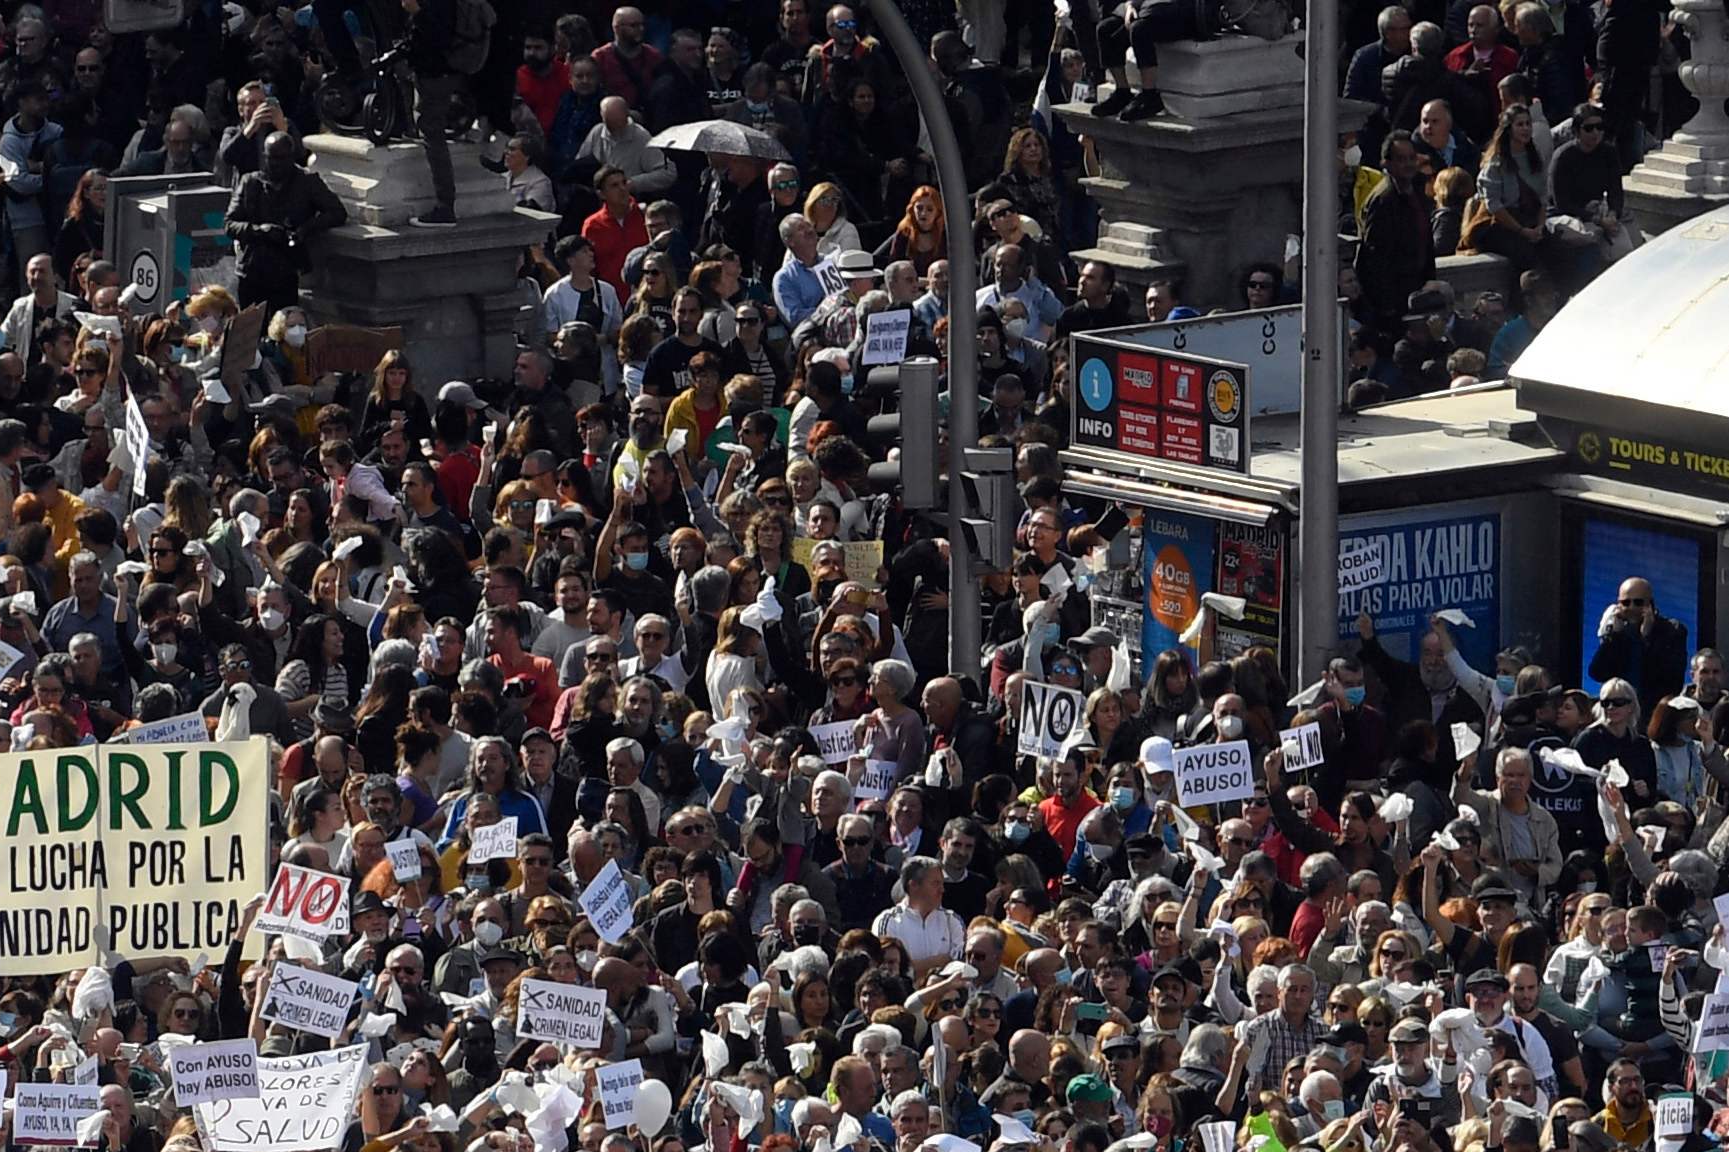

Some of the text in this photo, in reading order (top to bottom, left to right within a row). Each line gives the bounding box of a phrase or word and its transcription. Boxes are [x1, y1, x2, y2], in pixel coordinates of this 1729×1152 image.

[136, 267, 154, 288] 86
[1079, 417, 1113, 439] INFO
[1609, 437, 1665, 465] TOURS
[1151, 518, 1189, 540] LEBARA
[1415, 521, 1493, 579] KAHLO
[1338, 574, 1494, 617] ALAS PARA VOLAR
[1022, 683, 1077, 743] NO
[1177, 748, 1248, 778] ¡AYUSO,
[1181, 772, 1248, 798] ABUSO!
[10, 836, 245, 893] LUCHA POR LA
[264, 866, 342, 925] NO
[0, 907, 90, 957] NIDAD
[110, 899, 239, 952] PUBLICA
[295, 979, 350, 1010] SANIDAD,
[546, 993, 603, 1019] SANIDAD,
[279, 1000, 344, 1033] CRIMEN LEGAL!
[533, 1016, 601, 1042] CRIMEN LEGAL!
[175, 1052, 252, 1075] Con AYUSO
[265, 1055, 291, 1070] NO
[296, 1055, 324, 1069] VA
[177, 1073, 258, 1098] hay ABUSO!
[18, 1092, 37, 1109] Como
[38, 1092, 62, 1112] Aguirre
[262, 1096, 288, 1112] VA
[23, 1114, 49, 1133] AYUSO,
[234, 1115, 340, 1146] SALUD
